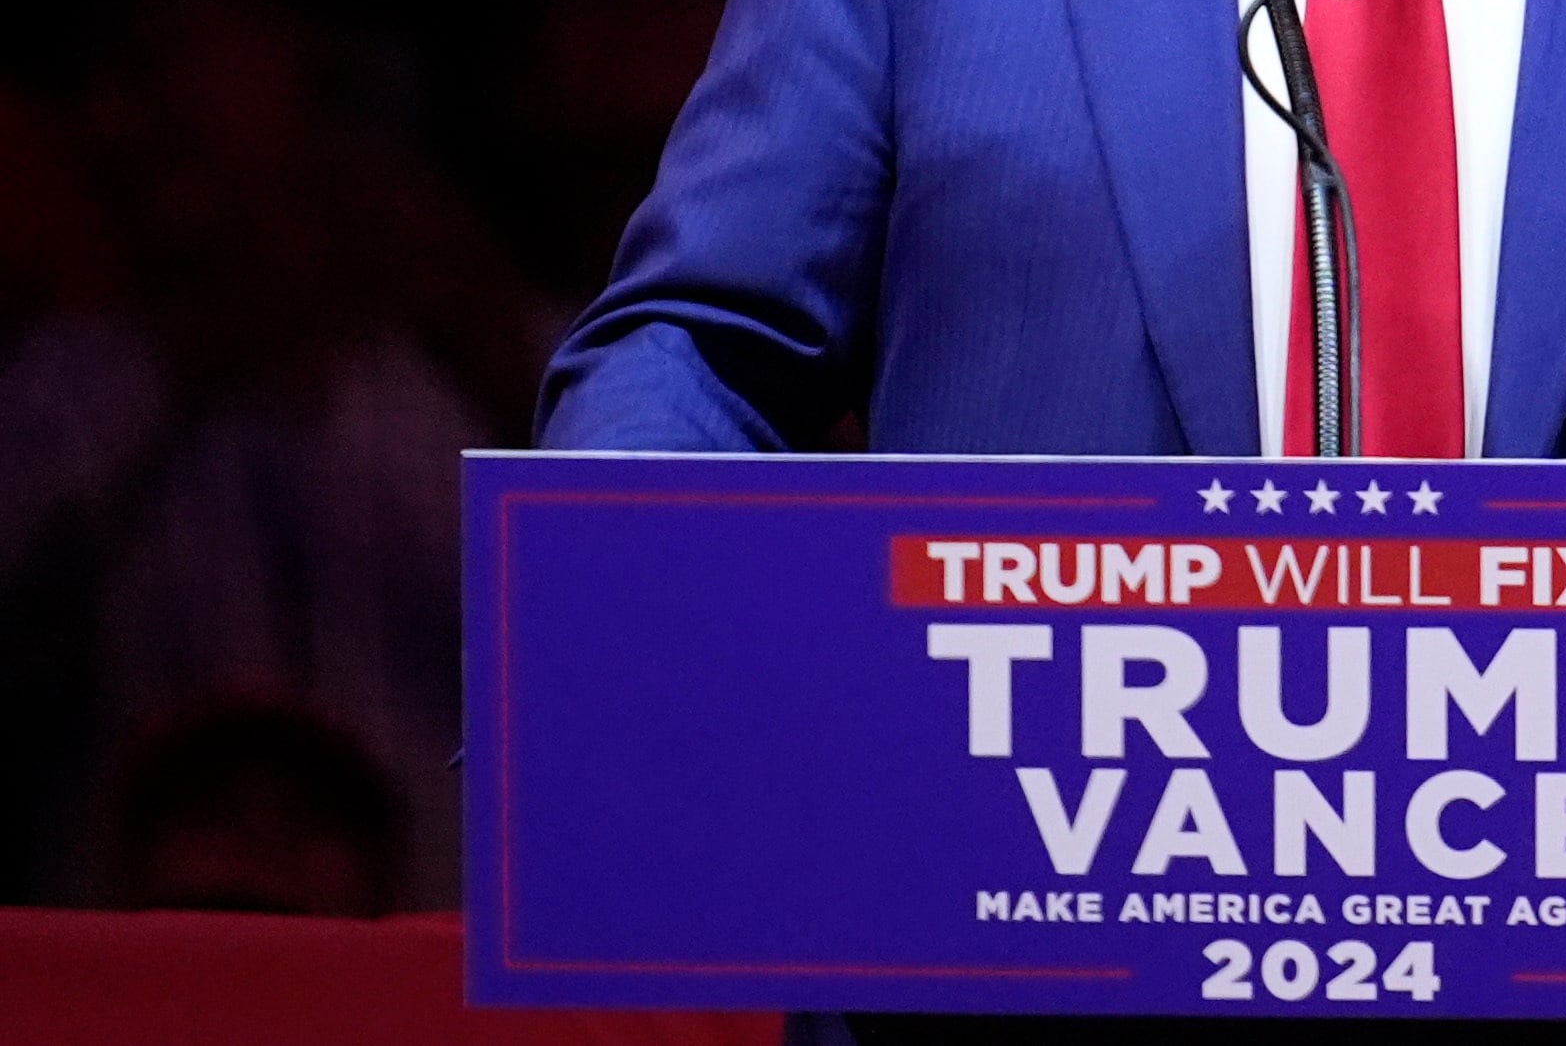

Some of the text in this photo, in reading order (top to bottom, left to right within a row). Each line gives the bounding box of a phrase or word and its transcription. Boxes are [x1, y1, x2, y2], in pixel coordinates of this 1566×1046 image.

[926, 541, 1223, 605] TRUMP
[1244, 544, 1452, 606] WILL
[976, 890, 1103, 923] MAKE
[1118, 892, 1326, 924] AMERICA
[1342, 894, 1491, 925] GREAT
[1201, 939, 1441, 1002] 2024
